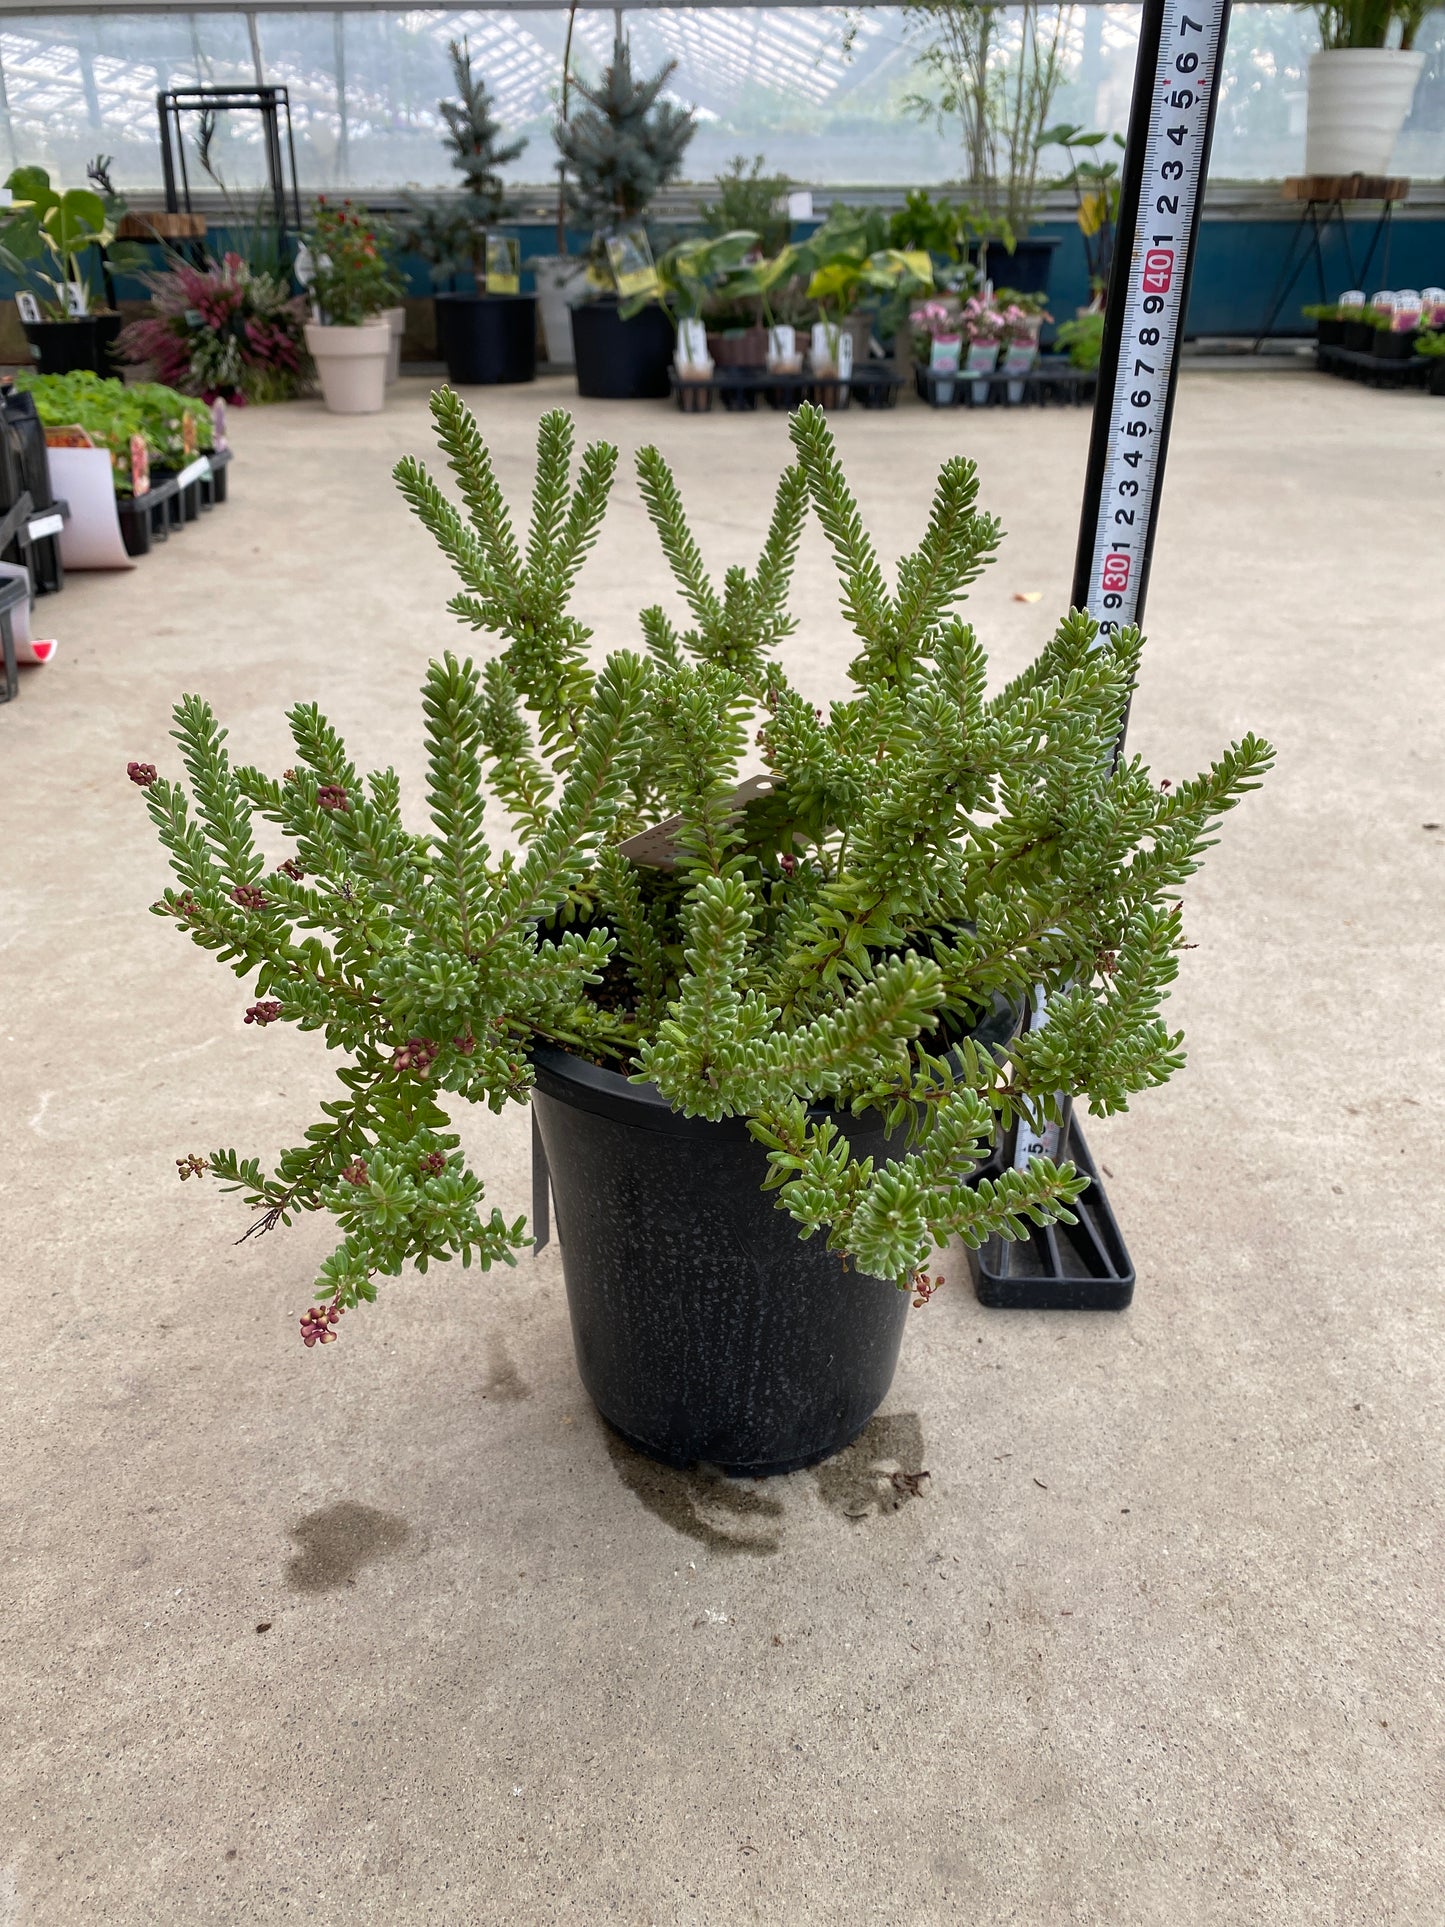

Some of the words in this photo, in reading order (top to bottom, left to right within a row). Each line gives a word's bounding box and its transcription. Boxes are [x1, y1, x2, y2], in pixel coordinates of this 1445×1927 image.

[1180, 15, 1203, 36] 7
[1175, 52, 1199, 74] 6
[1170, 89, 1194, 109] 5
[1167, 124, 1188, 146] 4
[1161, 160, 1183, 181] 3
[1156, 195, 1179, 214] 2
[1152, 235, 1173, 247] 1
[1146, 254, 1171, 287] 40
[1143, 295, 1164, 314] 9
[1139, 327, 1160, 346] 8
[1134, 359, 1155, 376] 7
[1130, 390, 1151, 408] 6
[1126, 420, 1147, 438] 5
[1123, 450, 1143, 468] 4
[1118, 479, 1139, 497] 3
[1115, 508, 1135, 526] 2
[1112, 542, 1131, 552] 1
[1104, 557, 1129, 587] 30
[1103, 592, 1123, 609] 9
[1028, 1142, 1044, 1154] 5
